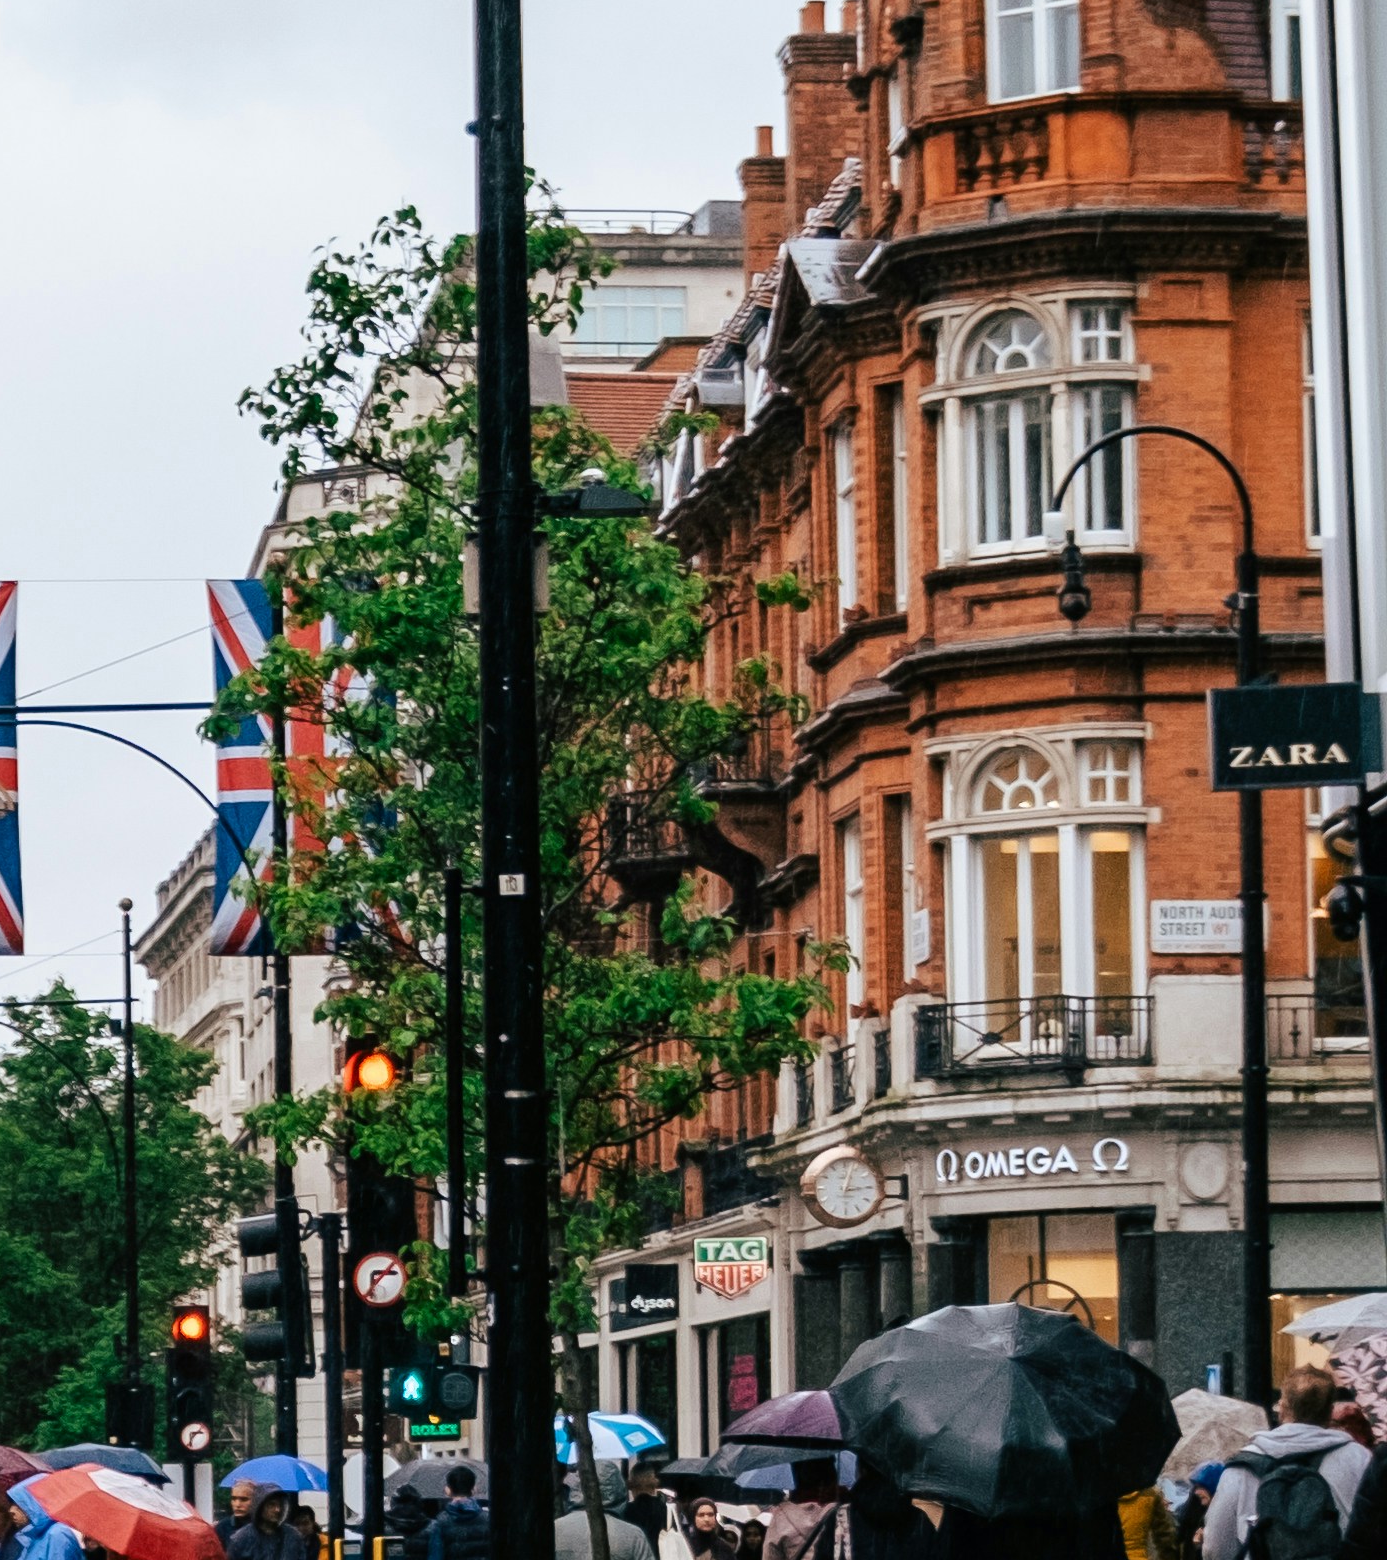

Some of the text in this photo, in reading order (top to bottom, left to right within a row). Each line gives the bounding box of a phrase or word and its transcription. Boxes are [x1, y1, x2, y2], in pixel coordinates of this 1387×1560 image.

[1229, 742, 1349, 768] ZARA
[1159, 906, 1204, 919] NORTH
[1159, 922, 1206, 936] STREET
[964, 1143, 1078, 1179] OMEGA
[700, 1241, 761, 1262] TAG
[698, 1265, 764, 1296] HEUER
[630, 1294, 676, 1313] dyson
[410, 1424, 459, 1437] ROLEX
